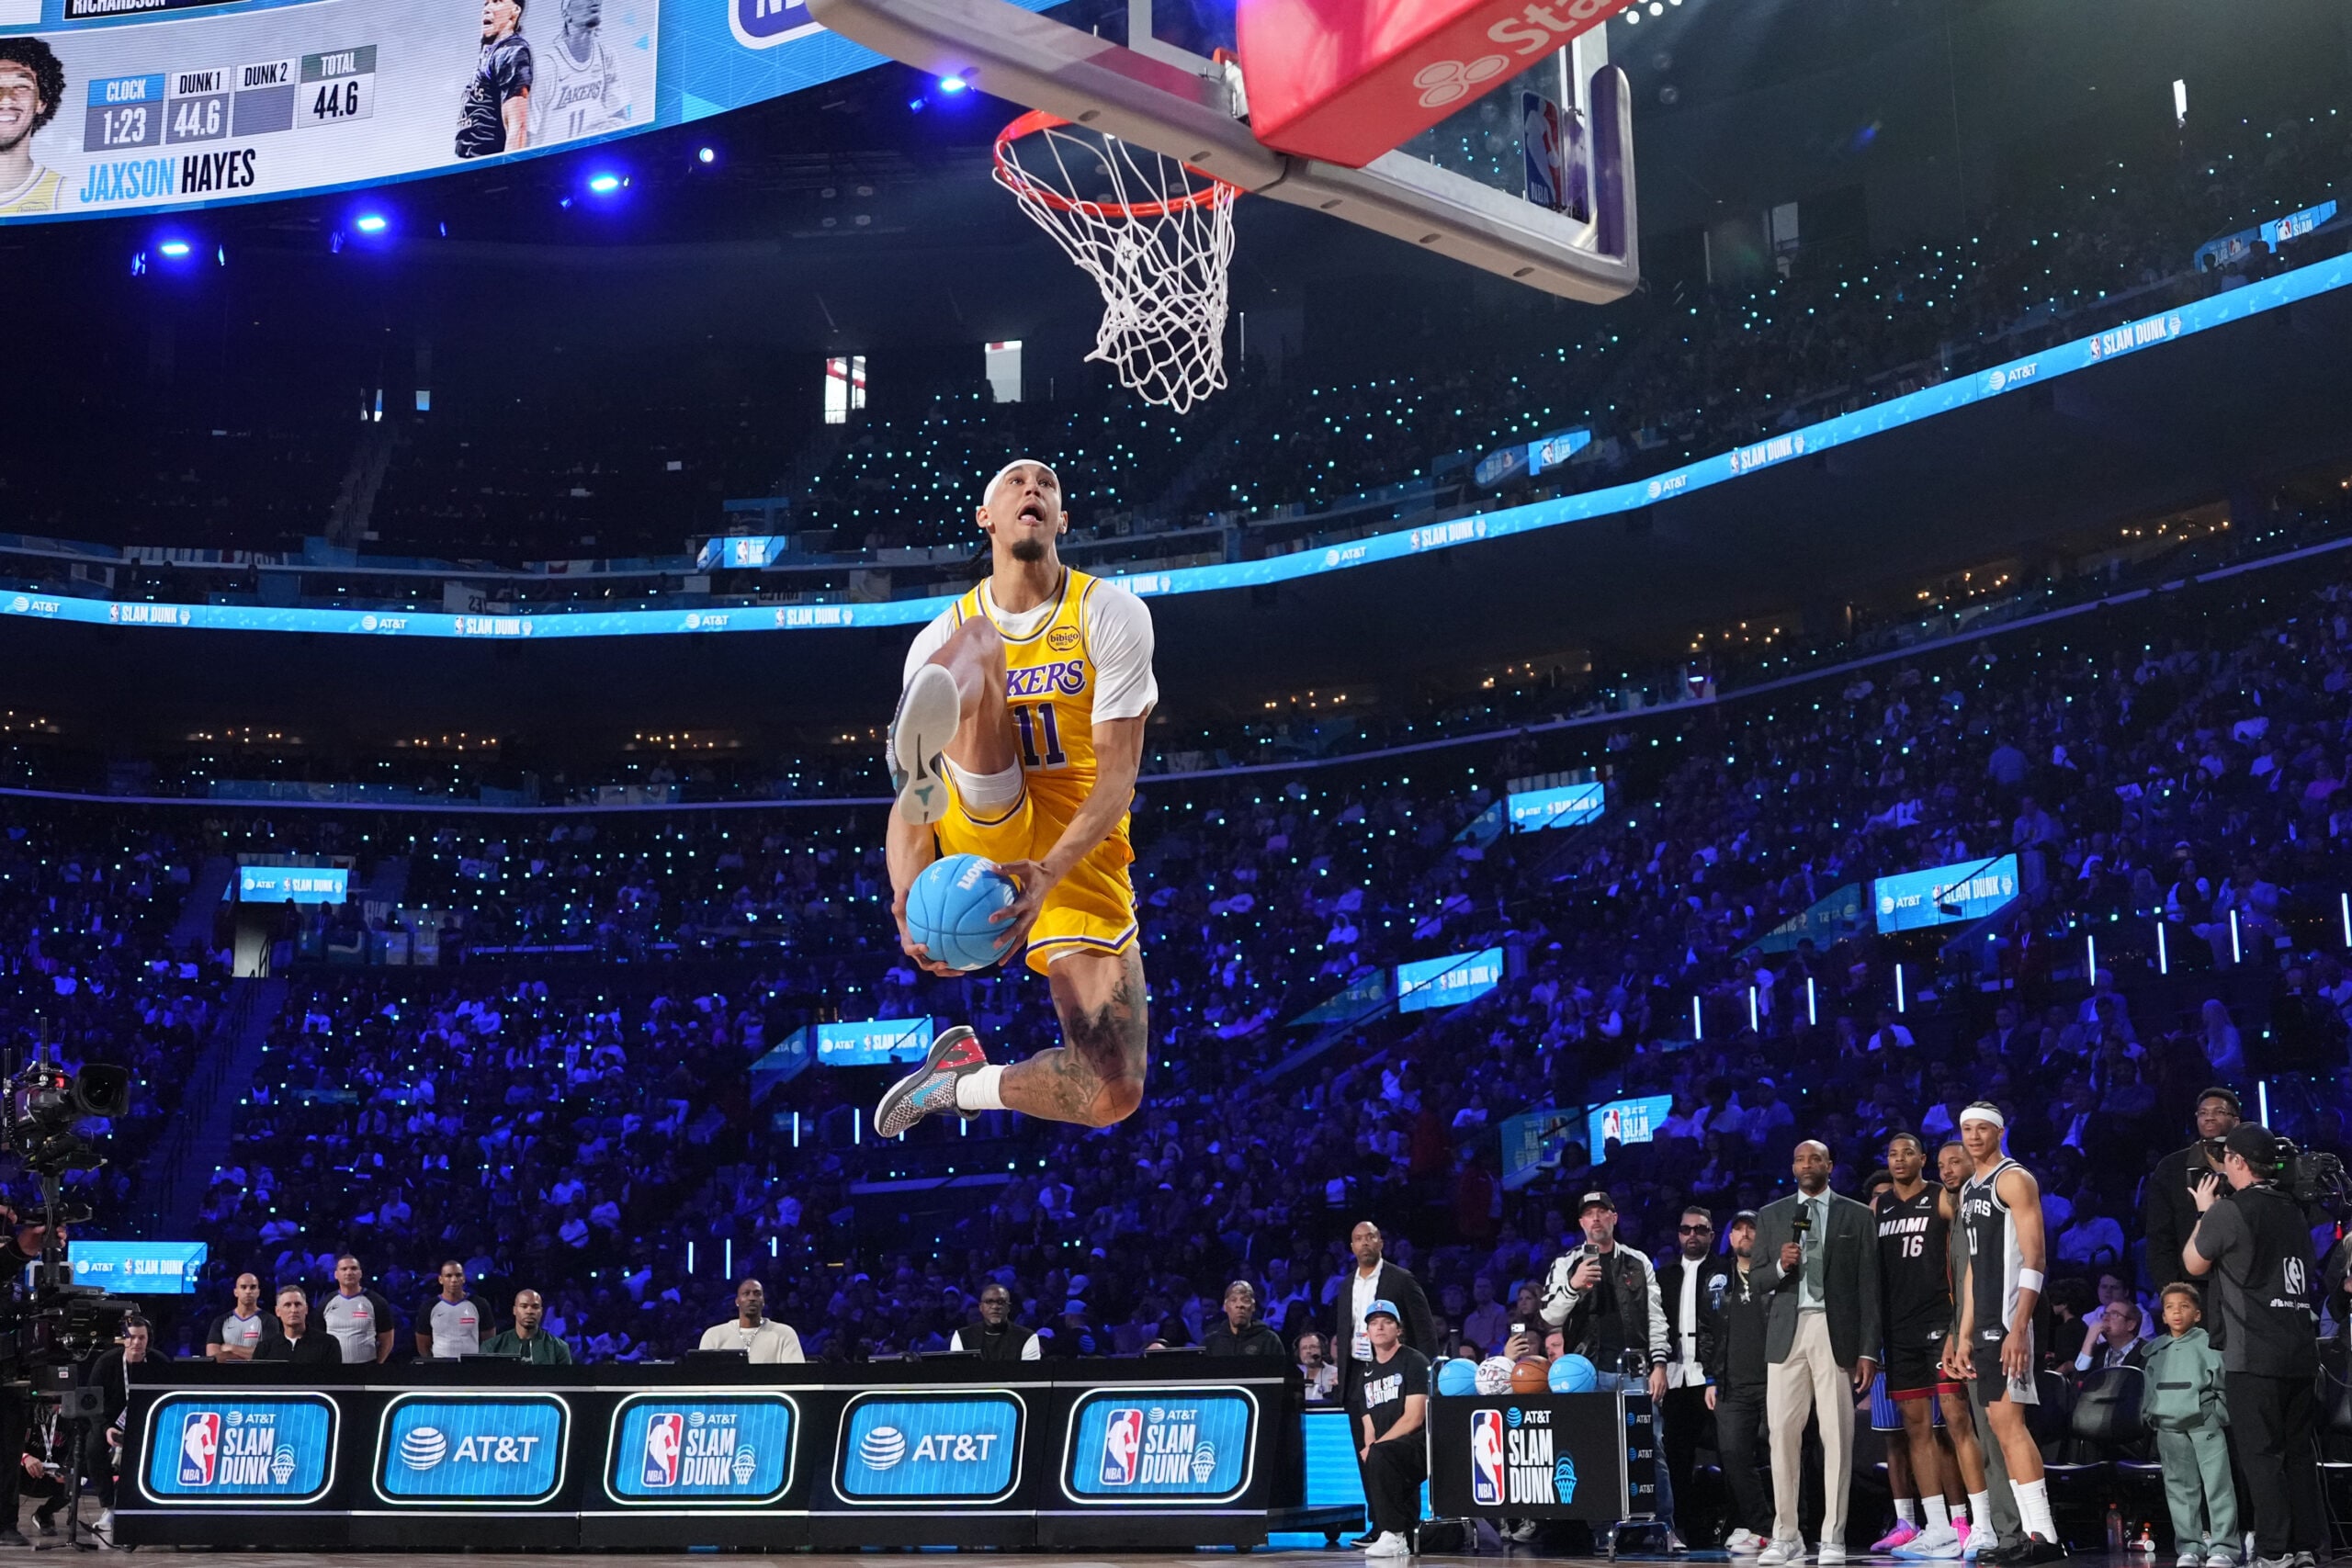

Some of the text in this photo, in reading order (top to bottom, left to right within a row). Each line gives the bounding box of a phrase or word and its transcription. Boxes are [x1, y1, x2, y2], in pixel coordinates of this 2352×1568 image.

[243, 62, 288, 87] DUNK 2
[320, 51, 357, 76] TOTAL
[106, 78, 147, 102] CLOCK
[179, 72, 221, 95] DUNK 1
[312, 81, 359, 119] 44.6
[553, 81, 603, 111] LAKERS
[103, 107, 147, 145] 1:23
[174, 99, 220, 137] 44.6
[80, 148, 256, 203] JAXSON HAYES
[2008, 317, 2166, 382] AT&T SLAM DUNK
[1663, 436, 1793, 492] AT&T SLAM DUNK
[1341, 519, 1475, 560] AT&T SLAM DUNK
[1132, 576, 1159, 593] DUNK
[31, 602, 177, 624] AT&T SLAM DUNK
[702, 607, 841, 627] AT&T SLAM DUNK
[379, 617, 521, 636] AT&T SLAM DUNK
[1049, 633, 1080, 644] bibigo
[1007, 660, 1086, 696] KERS
[1014, 702, 1069, 771] 11
[255, 878, 334, 893] AT&T SLAM DUNK
[1895, 875, 2000, 908] AT&T SLAM DUNK
[1448, 969, 1469, 988] SLAM
[1470, 965, 1489, 985] DUNK
[833, 1039, 855, 1050] AT&T
[873, 1033, 896, 1050] SLAM
[1623, 1116, 1649, 1139] SLAM
[1878, 1216, 1929, 1237] MIAMI
[1902, 1235, 1925, 1258] 16
[91, 1259, 184, 1275] AT&T SLAM DUNK
[245, 1414, 277, 1424] AT&T
[707, 1414, 739, 1425] AT&T
[1166, 1409, 1198, 1420] AT&T
[1524, 1411, 1552, 1424] AT&T
[1635, 1415, 1652, 1424] AT&T
[223, 1427, 275, 1456] SLAM
[453, 1436, 539, 1463] AT&T
[685, 1428, 737, 1457] SLAM
[911, 1434, 998, 1461] AT&T
[1145, 1424, 1197, 1454] SLAM
[1508, 1428, 1554, 1466] SLAM
[1637, 1449, 1654, 1459] AT&T
[182, 1469, 200, 1482] NBA
[220, 1456, 273, 1485] DUNK
[645, 1470, 663, 1483] NBA
[682, 1456, 733, 1486] DUNK
[1104, 1468, 1122, 1480] NBA
[1140, 1454, 1193, 1484] DUNK
[1477, 1483, 1494, 1499] NBA
[1509, 1466, 1555, 1504] DUNK
[1638, 1484, 1655, 1494] AT&T
